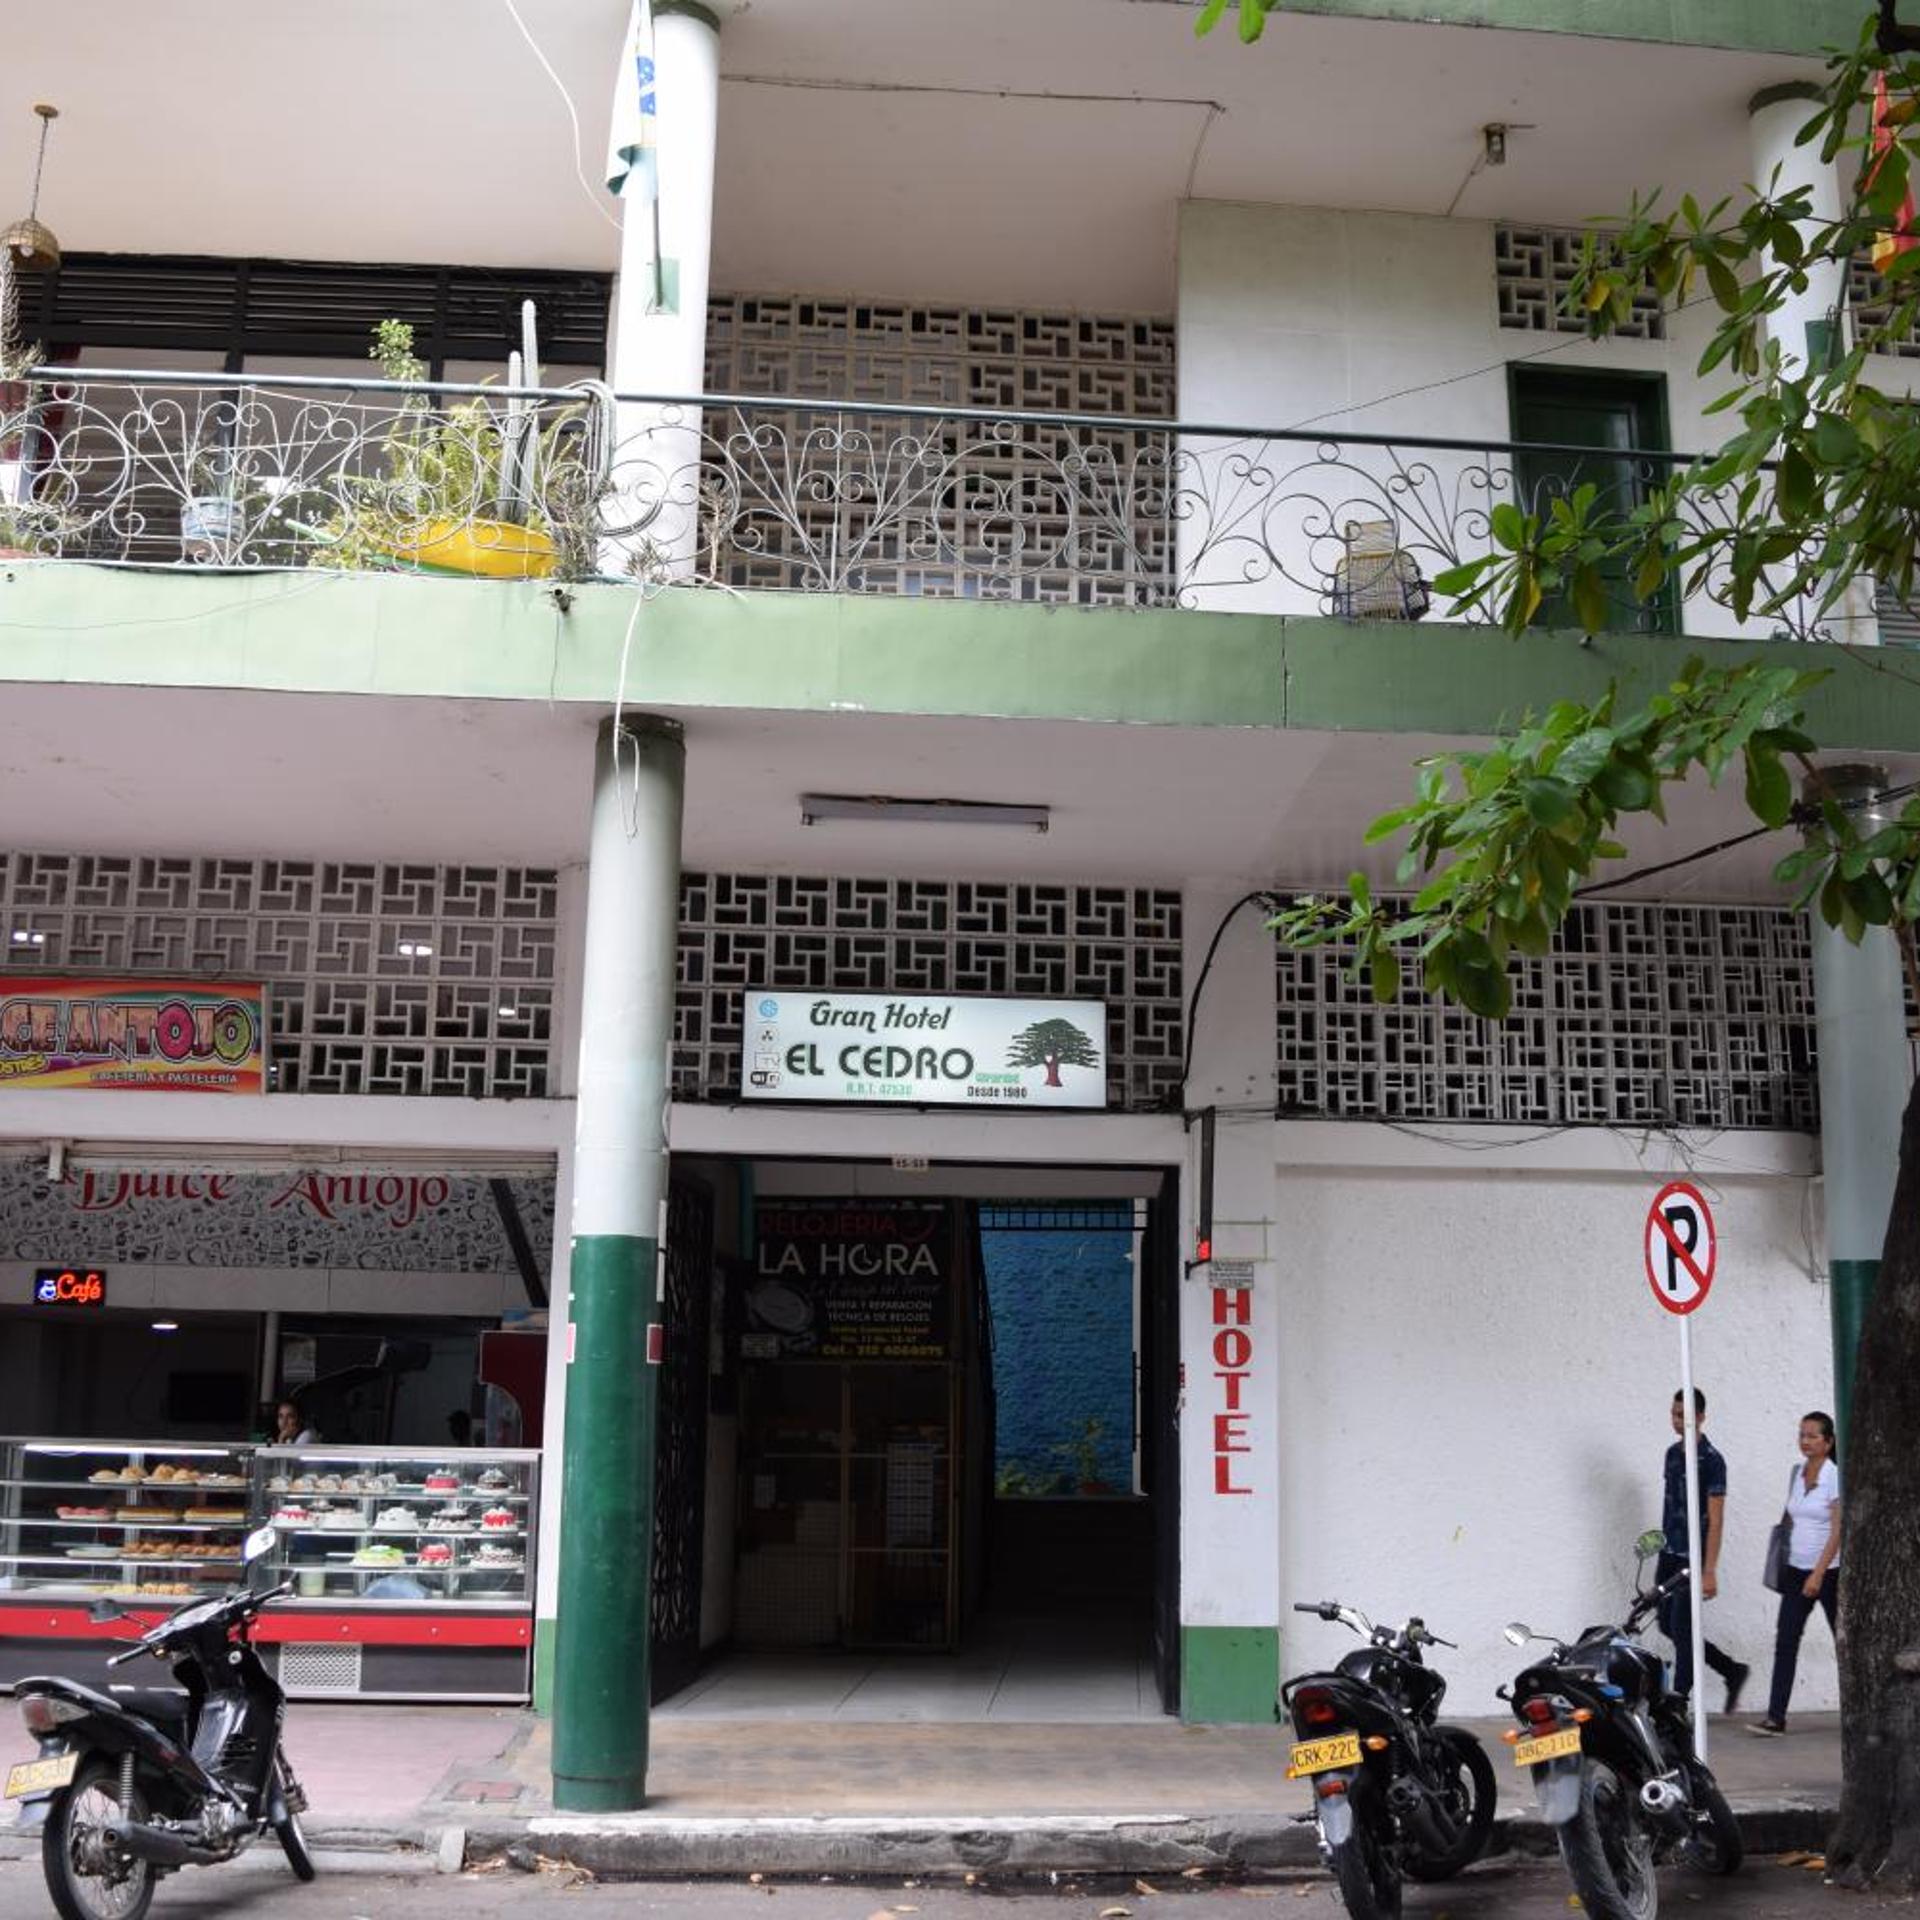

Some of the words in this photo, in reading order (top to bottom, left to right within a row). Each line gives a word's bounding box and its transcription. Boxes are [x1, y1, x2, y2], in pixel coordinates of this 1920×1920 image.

[810, 1000, 875, 1033] Gran
[884, 1004, 952, 1030] Hotel
[786, 1044, 824, 1076] EL
[838, 1046, 974, 1080] CEDRO
[967, 1086, 1000, 1098] Desde
[759, 1243, 805, 1275] LA
[820, 1243, 939, 1276] HORA
[1664, 1205, 1698, 1291] P
[57, 1273, 102, 1303] Café
[1212, 1287, 1252, 1494] HOTEL
